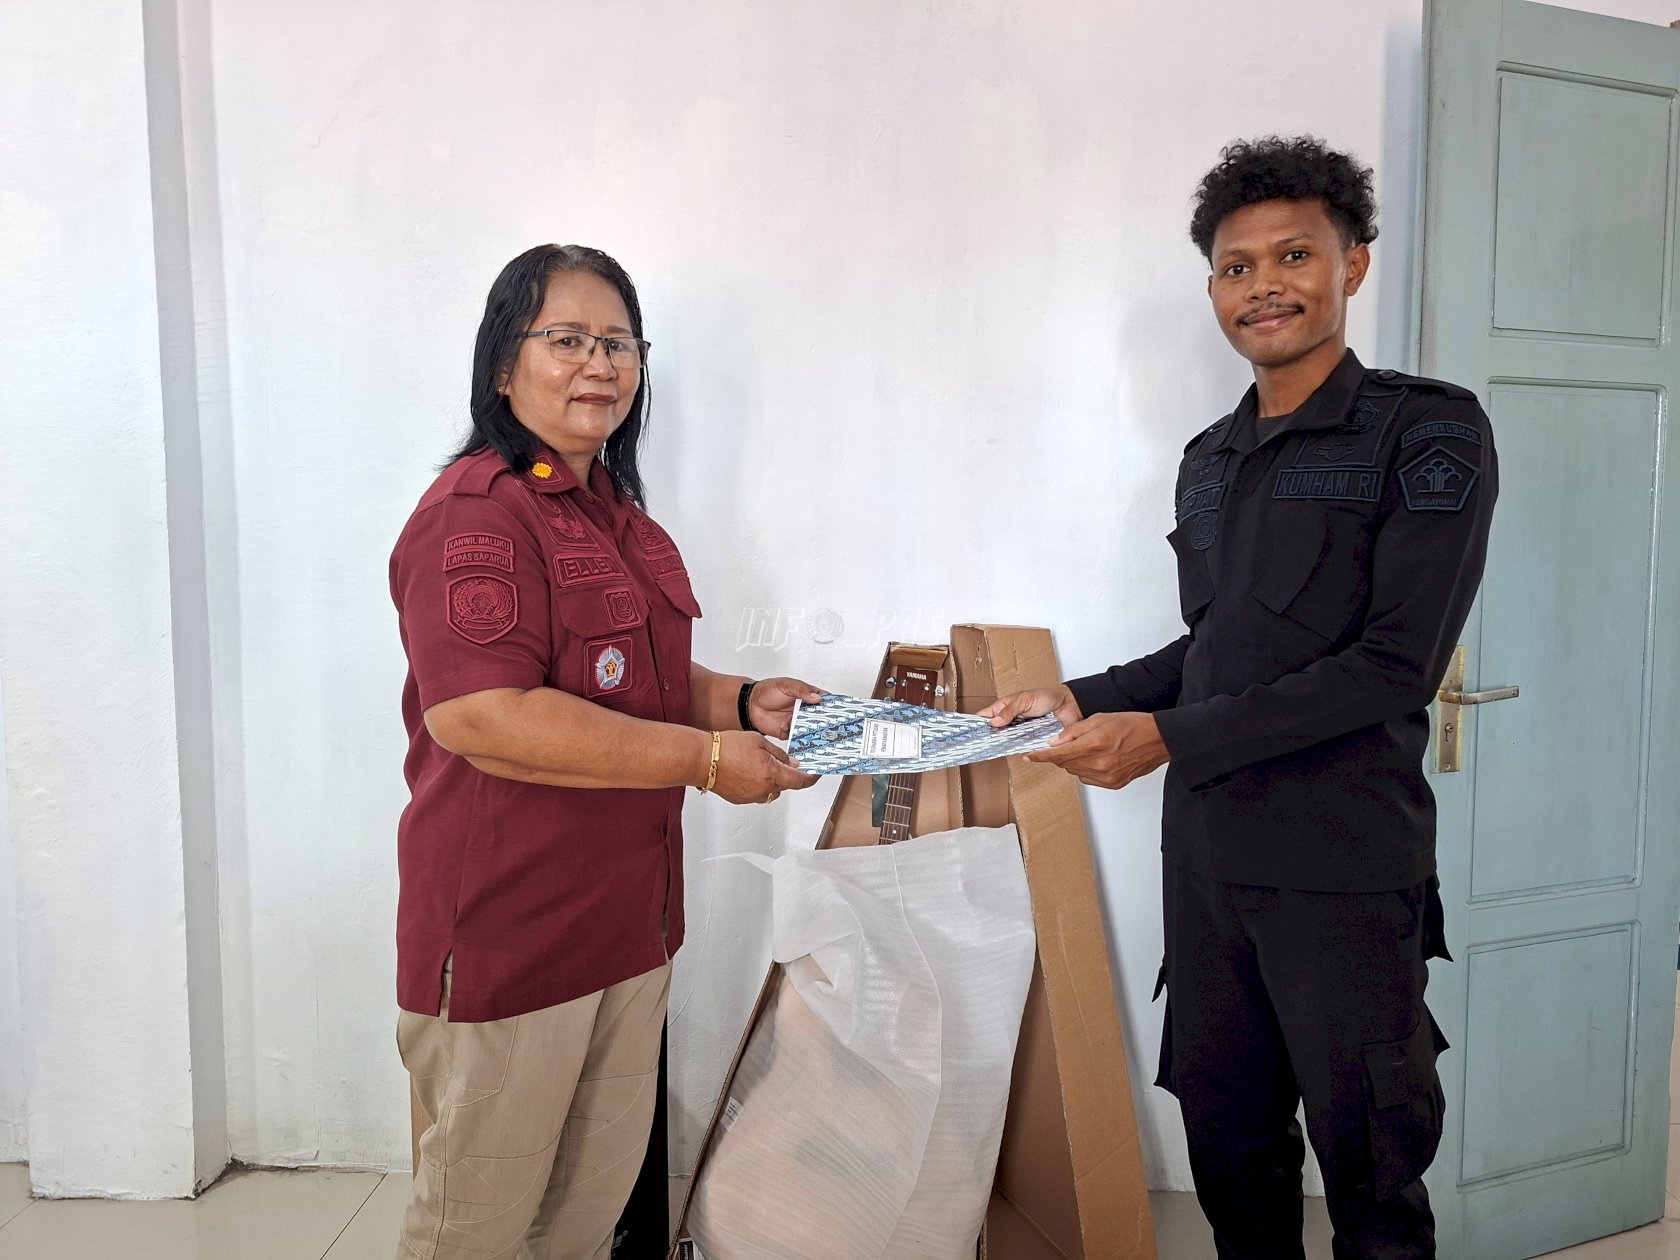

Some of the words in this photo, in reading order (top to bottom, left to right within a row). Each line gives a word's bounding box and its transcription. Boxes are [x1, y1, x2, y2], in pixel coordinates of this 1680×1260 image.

[1277, 471, 1350, 497] KUMHAM
[1358, 472, 1377, 498] RI
[448, 535, 478, 551] KANWIL
[478, 535, 510, 551] MALUKU
[447, 552, 473, 566] LAPAS
[473, 552, 510, 568] SAPARUA
[906, 671, 927, 681] YAMAHA
